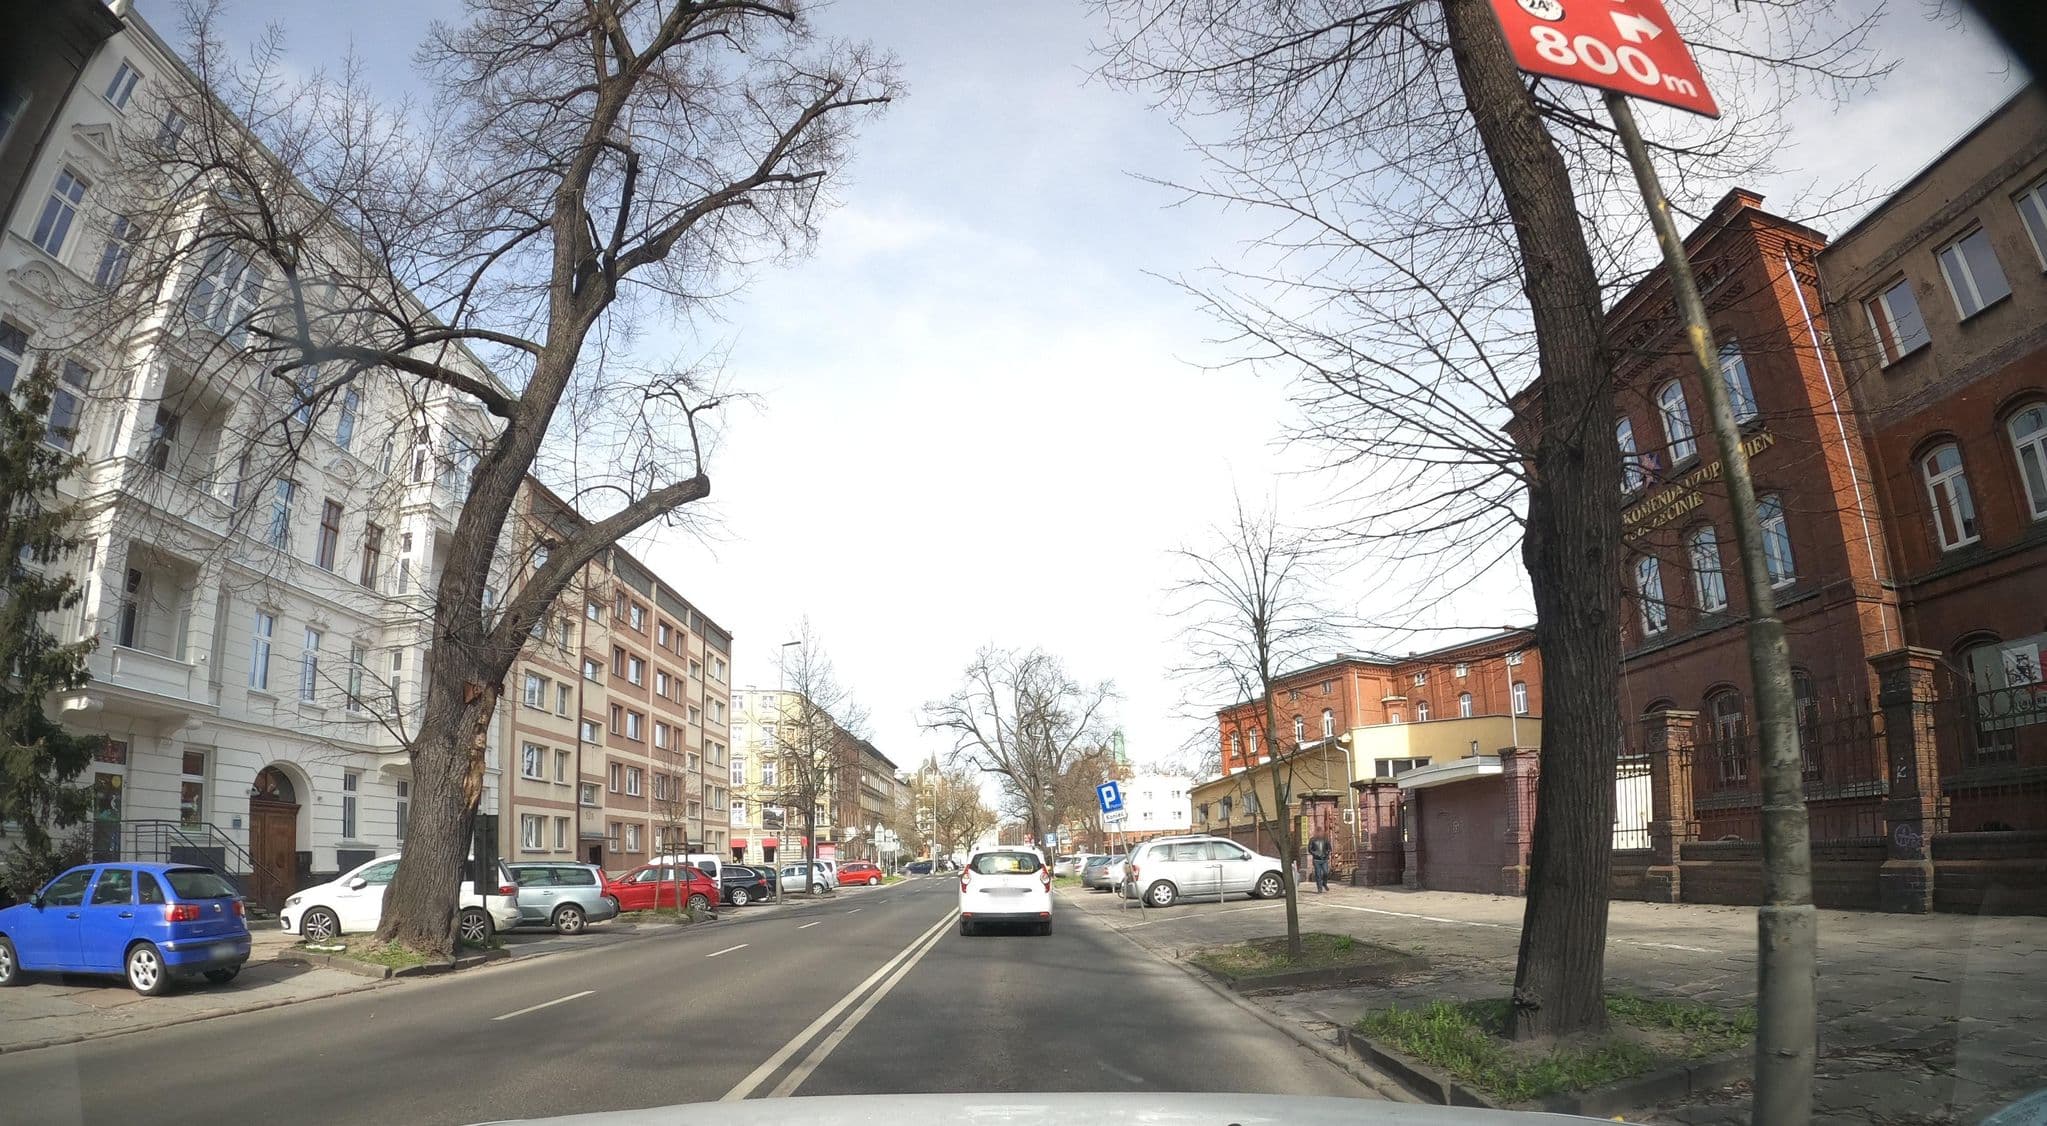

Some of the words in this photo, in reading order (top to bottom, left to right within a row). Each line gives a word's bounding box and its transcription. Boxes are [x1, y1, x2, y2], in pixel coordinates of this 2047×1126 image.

[1623, 485, 1683, 524] KOMENDA
[1685, 426, 1776, 488] UZUPIEŃ
[1101, 785, 1116, 809] P
